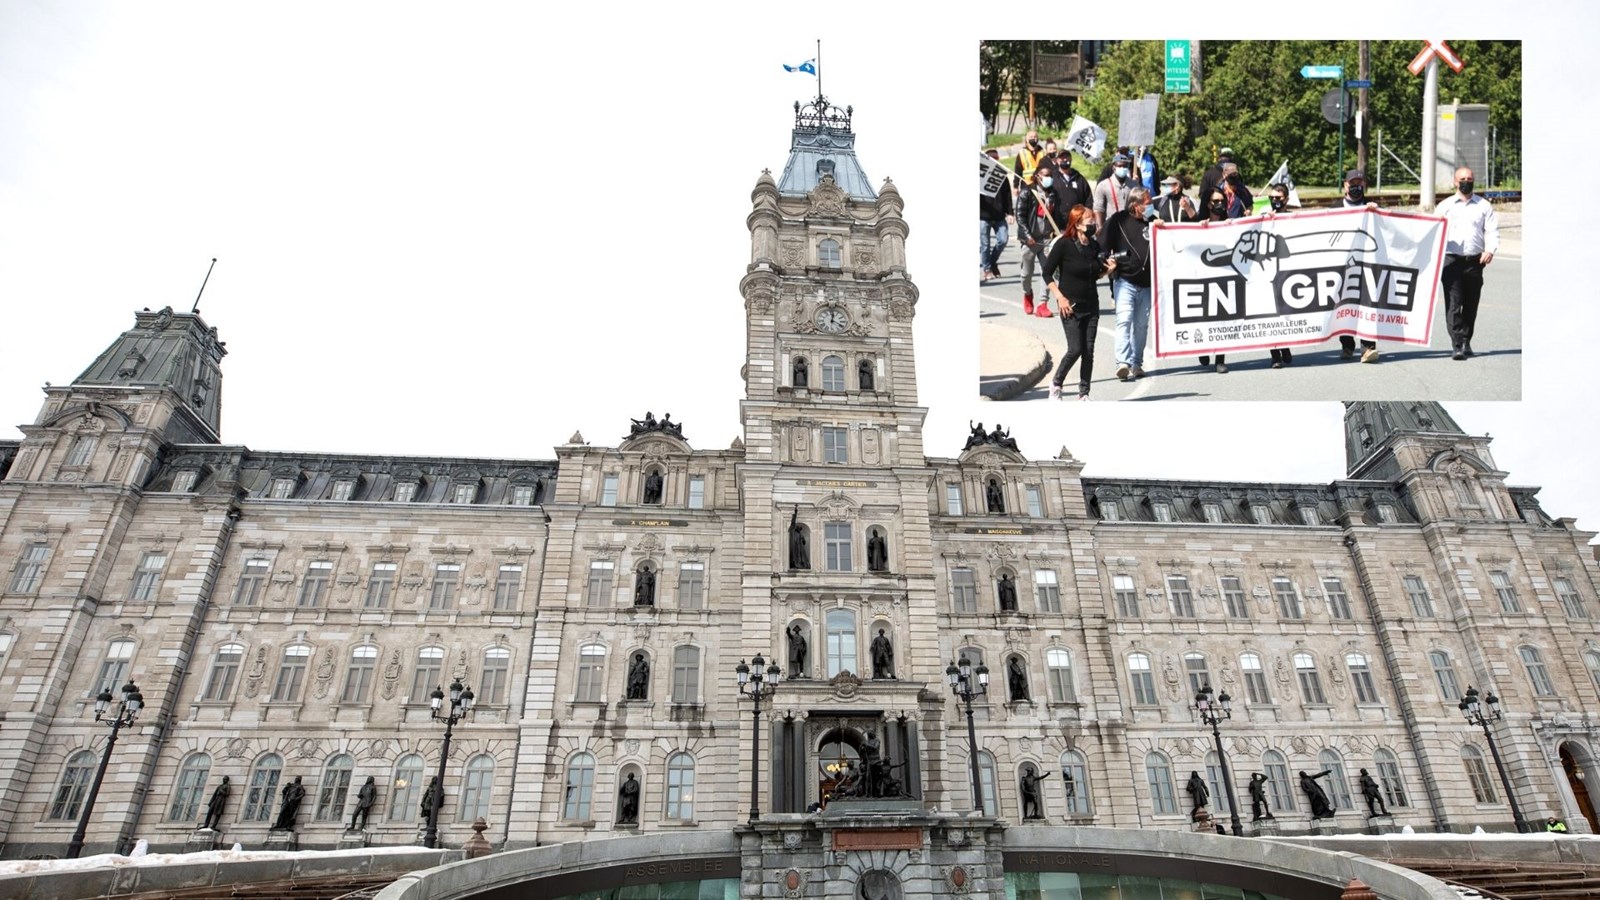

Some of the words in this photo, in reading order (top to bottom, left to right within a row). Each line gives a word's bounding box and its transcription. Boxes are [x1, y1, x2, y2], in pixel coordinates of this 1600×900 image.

[1075, 138, 1092, 151] CSN
[1178, 280, 1237, 318] EN
[1281, 255, 1413, 309] GRÈVE
[1336, 308, 1363, 320] DEPUIS
[1365, 312, 1376, 322] LE
[1385, 315, 1409, 325] AVRIL
[1208, 325, 1241, 334] SYNDICAT
[1242, 324, 1256, 332] DES
[1258, 319, 1308, 330] TRAVAILLEURS
[1176, 330, 1189, 341] FC
[1208, 333, 1240, 342] D'OLYMEL
[1018, 854, 1111, 867] NATIONALE
